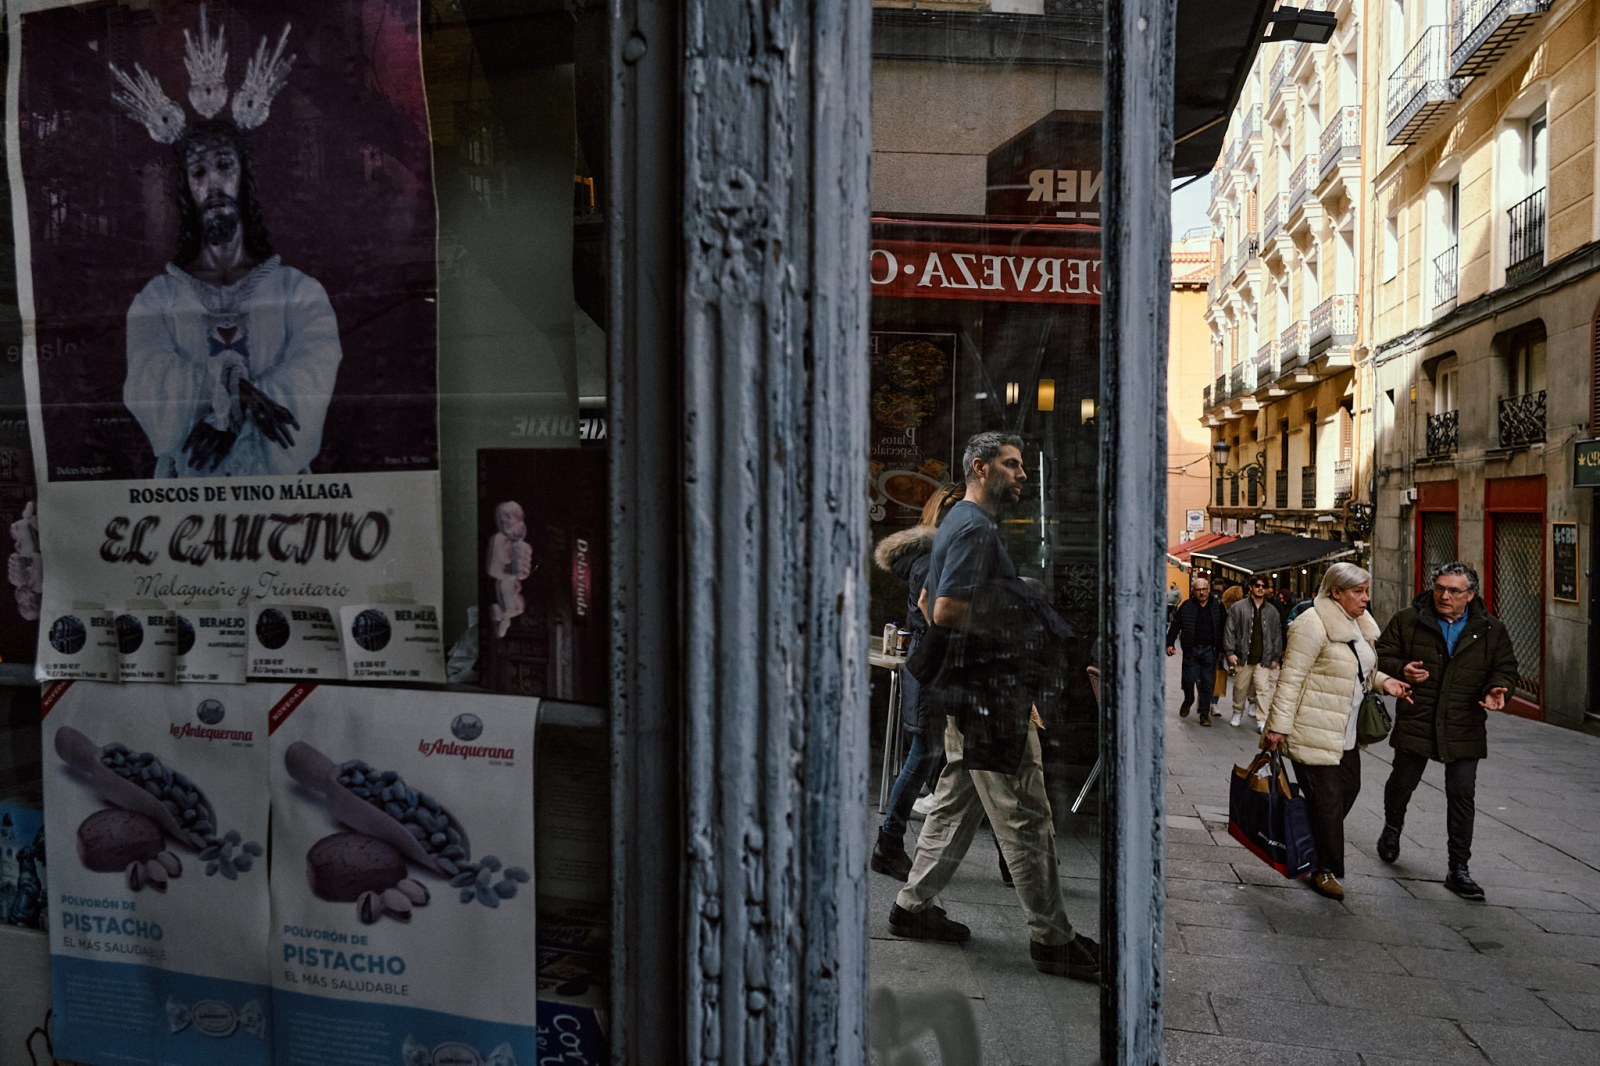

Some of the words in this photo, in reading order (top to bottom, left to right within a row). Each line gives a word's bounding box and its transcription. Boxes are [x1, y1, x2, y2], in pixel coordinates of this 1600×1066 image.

[129, 486, 199, 504] ROSCOS
[204, 486, 227, 502] DE
[231, 484, 275, 501] VINO
[280, 479, 353, 500] MÁLAGA
[100, 514, 160, 566] EL
[169, 510, 390, 567] CAUTIVO
[135, 573, 237, 606] Malagueño
[241, 586, 253, 607] y
[255, 571, 350, 600] Trinitario
[576, 538, 589, 617] Delaviuda
[200, 617, 246, 628] BERMEJO
[271, 687, 304, 721] NOVEDAD
[61, 895, 119, 910] POLVORÓN
[122, 900, 136, 911] DE
[62, 911, 163, 941] PISTACHO
[283, 924, 348, 943] POLVORÓN
[351, 934, 368, 946] DE
[64, 937, 75, 948] EL
[78, 938, 101, 952] MÁS
[104, 941, 167, 961] SALUDABLE
[283, 943, 406, 975] PISTACHO
[285, 971, 297, 982] EL
[302, 972, 328, 988] MÁS
[332, 978, 409, 996] SALUDABLE
